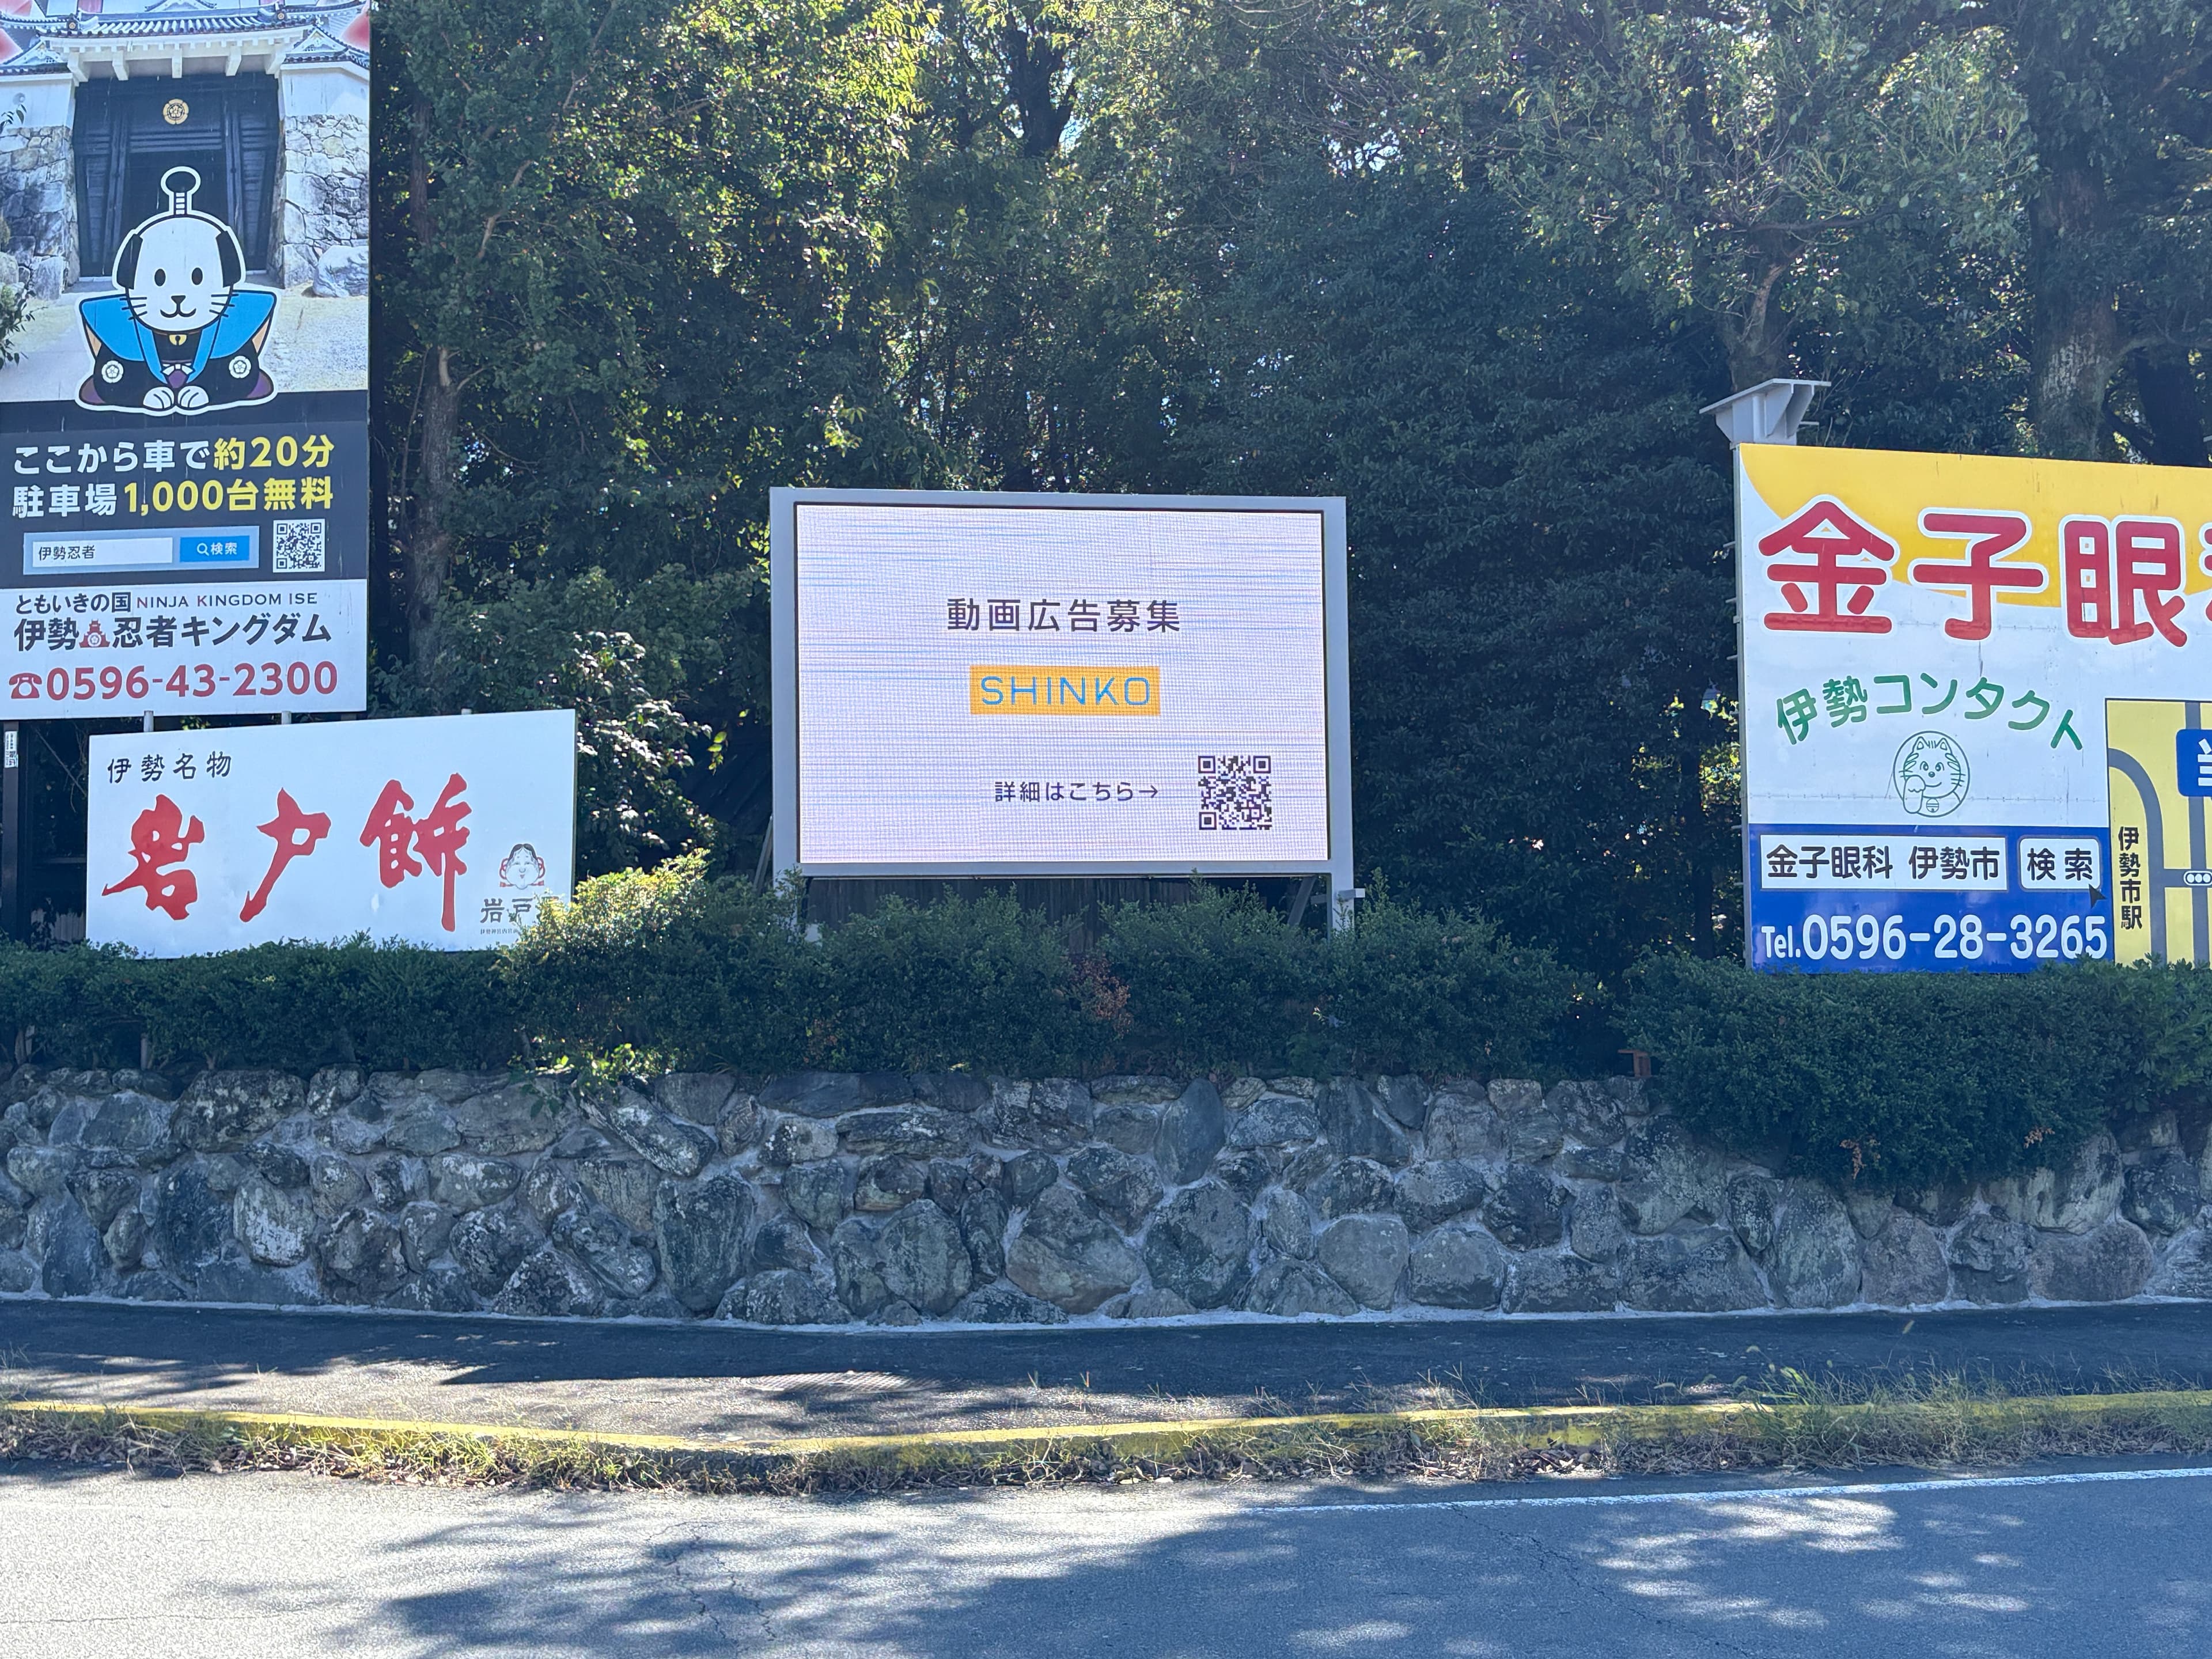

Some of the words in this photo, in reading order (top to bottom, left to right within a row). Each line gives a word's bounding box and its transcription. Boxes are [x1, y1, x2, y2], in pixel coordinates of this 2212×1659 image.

[14, 434, 335, 475] ここから車で約20分
[12, 476, 333, 518] 駐車場1,000台無料
[39, 546, 96, 560] 伊勢忍者
[210, 542, 237, 556] 検索
[1759, 501, 2212, 647] 金子眼
[16, 592, 132, 614] ともいきの国
[137, 596, 189, 608] NINJA
[197, 594, 282, 607] KINGDOM
[289, 593, 317, 605] ISE
[946, 597, 1181, 632] 動画広告募集
[47, 661, 338, 700] 0596-43-2300
[980, 675, 1151, 706] SHINKO
[1777, 673, 2084, 751] 伊勢コンタクト
[107, 751, 232, 783] 伊勢名物
[994, 781, 1134, 803] 詳細はこちら
[1766, 844, 1893, 878] 金子眼科
[1908, 846, 2000, 880] 伊勢市
[2027, 848, 2093, 881] 検索
[2118, 826, 2143, 930] 伊勢市駅
[480, 896, 560, 923] 岩戸
